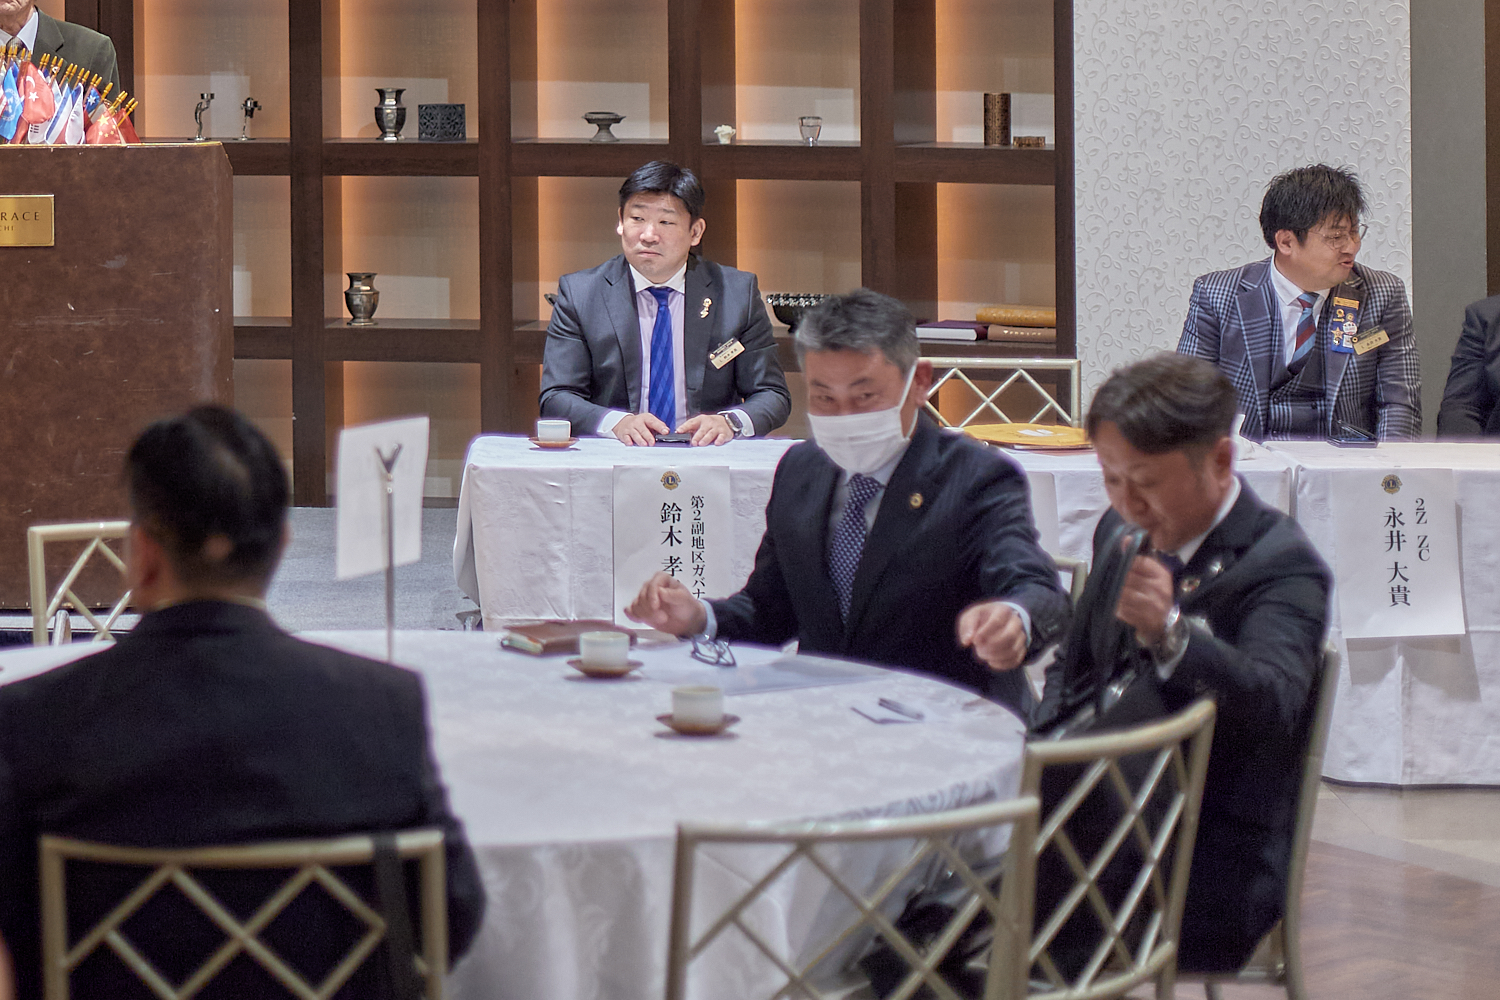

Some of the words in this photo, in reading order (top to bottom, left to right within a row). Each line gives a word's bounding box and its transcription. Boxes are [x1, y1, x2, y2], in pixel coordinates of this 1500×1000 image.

[660, 502, 683, 547] 鈴木
[1415, 497, 1428, 525] 2Z
[1383, 506, 1407, 553] 永井
[1417, 535, 1431, 562] ZC
[660, 555, 684, 583] 孝
[1387, 561, 1412, 608] 大貴
